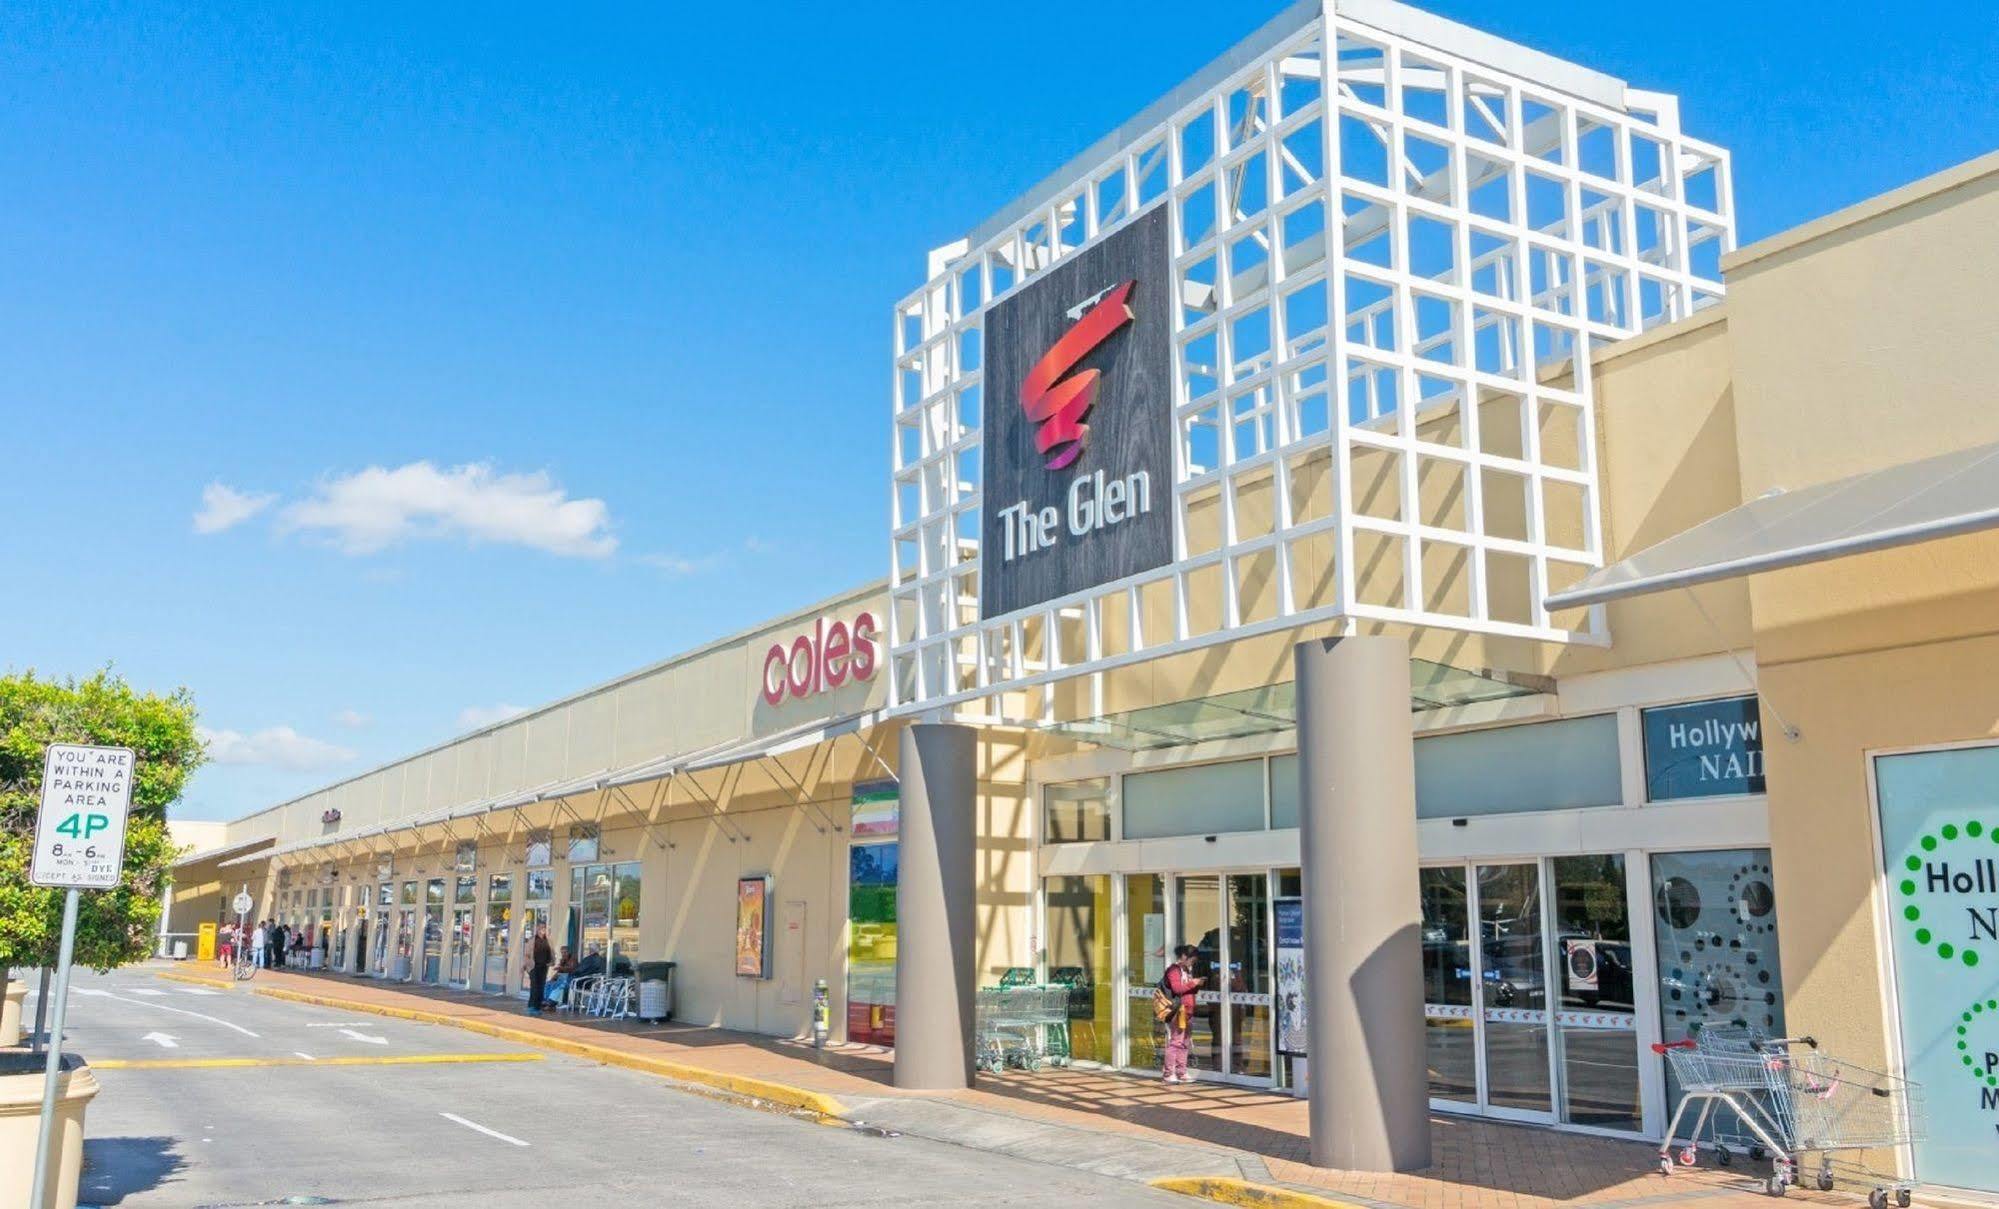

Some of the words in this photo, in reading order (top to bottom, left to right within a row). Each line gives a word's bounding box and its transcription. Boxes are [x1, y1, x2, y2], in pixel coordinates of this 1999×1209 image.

[998, 500, 1058, 561] The
[1068, 469, 1151, 536] Glen
[763, 612, 876, 706] coles
[1669, 719, 1758, 750] Hollyw
[57, 751, 86, 763] YOU
[96, 754, 127, 766] ARE
[54, 765, 104, 778] WITHIN
[114, 770, 123, 779] A
[53, 779, 121, 793] PARKING
[64, 794, 107, 806] AREA
[56, 813, 109, 839] 4P
